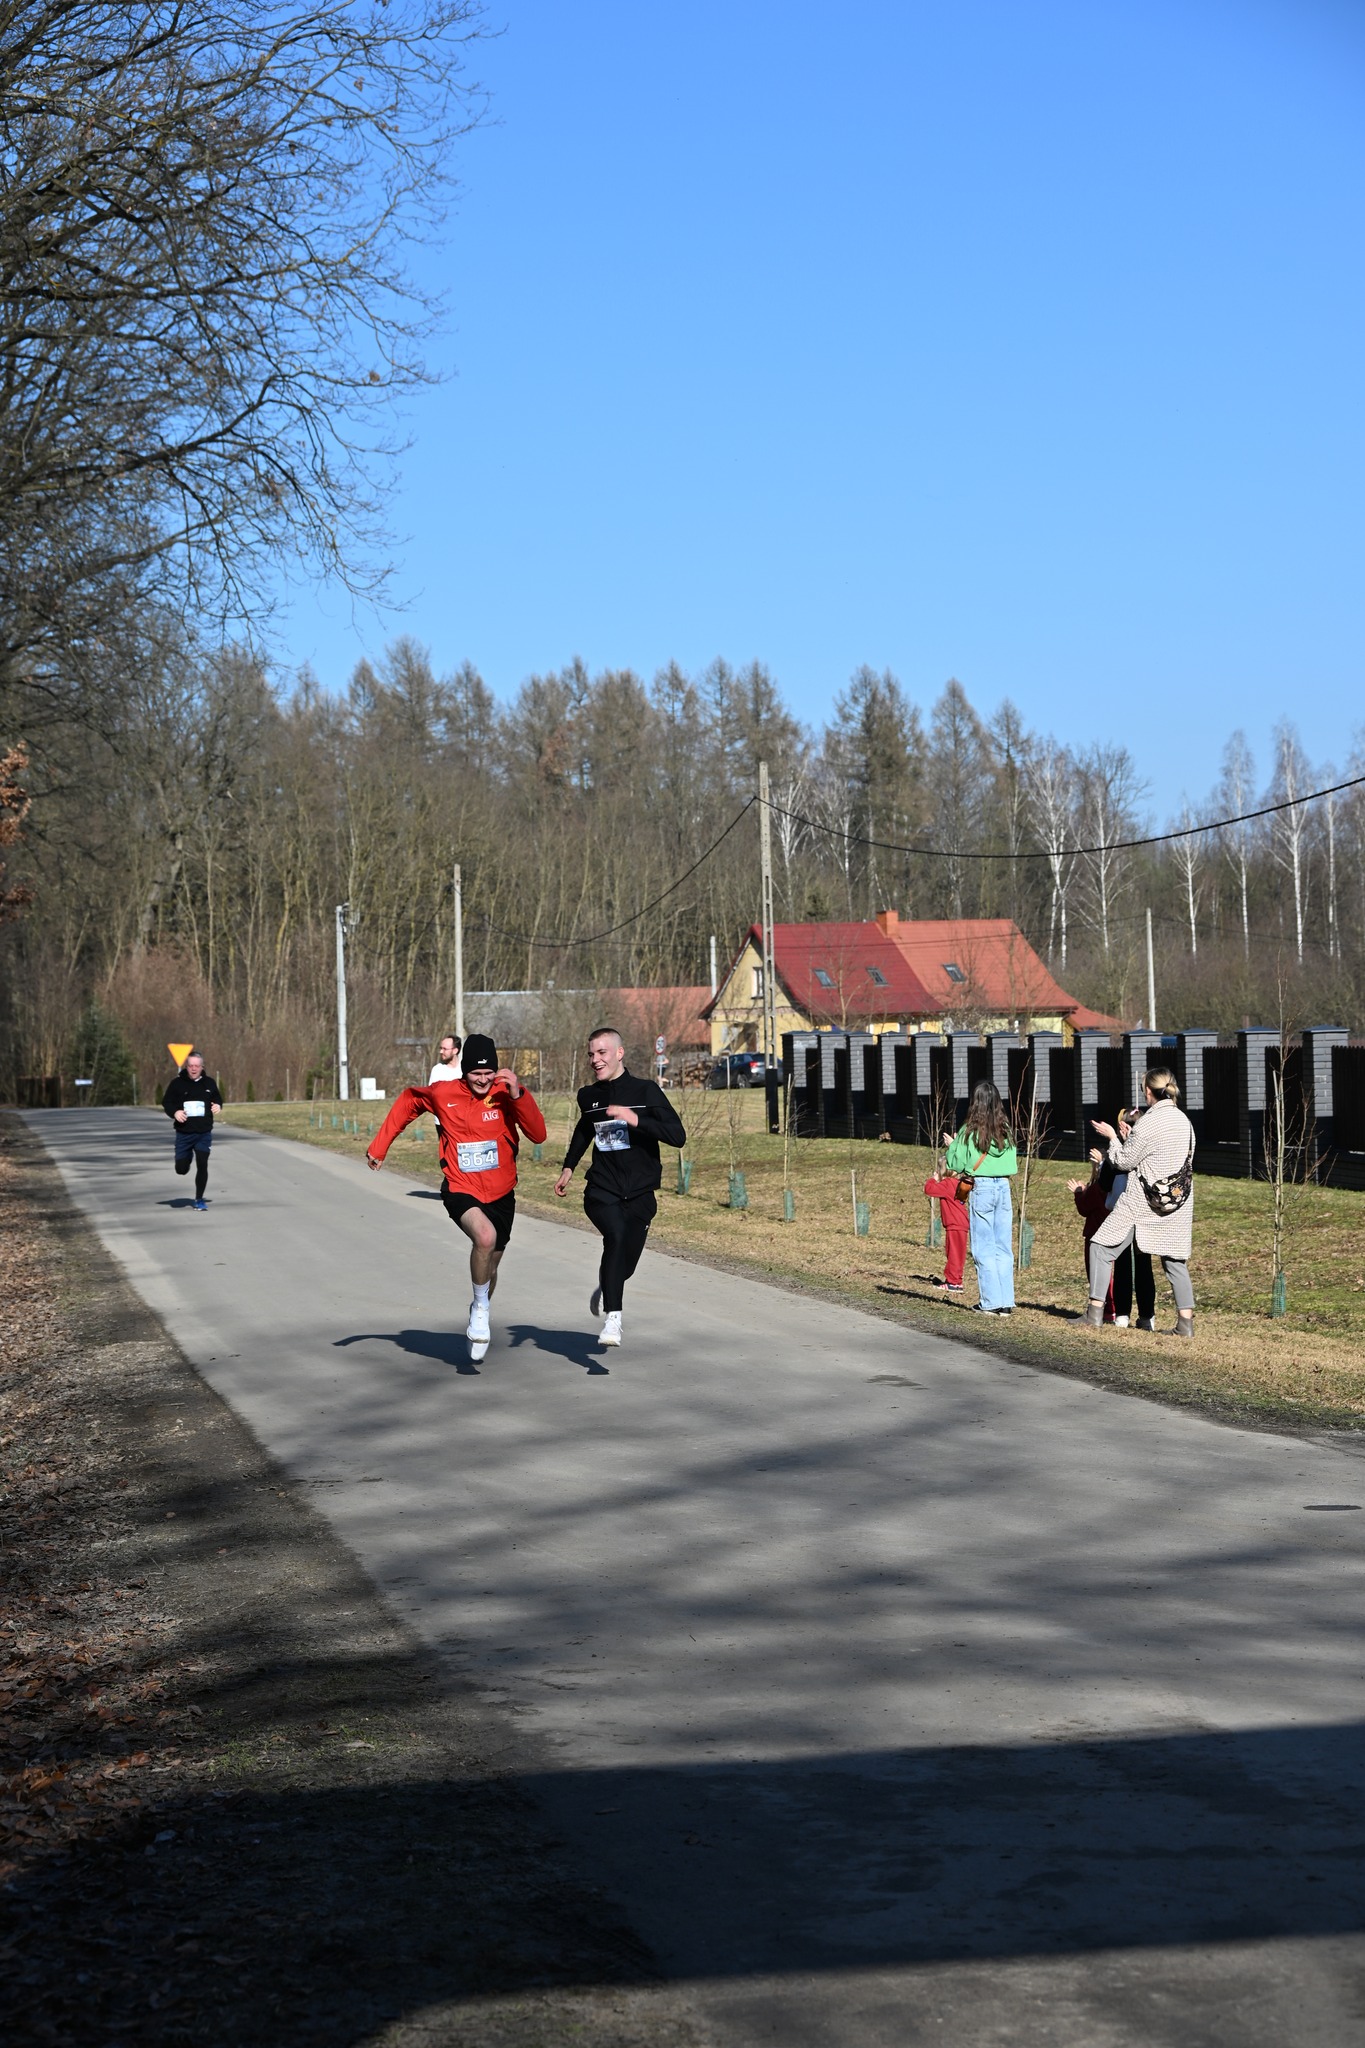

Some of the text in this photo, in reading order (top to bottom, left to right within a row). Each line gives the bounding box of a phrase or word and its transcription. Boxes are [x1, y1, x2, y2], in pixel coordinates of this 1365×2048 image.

[657, 1039, 664, 1050] 50
[482, 1110, 498, 1121] AIG
[598, 1129, 626, 1146] 542
[461, 1150, 496, 1167] 564
